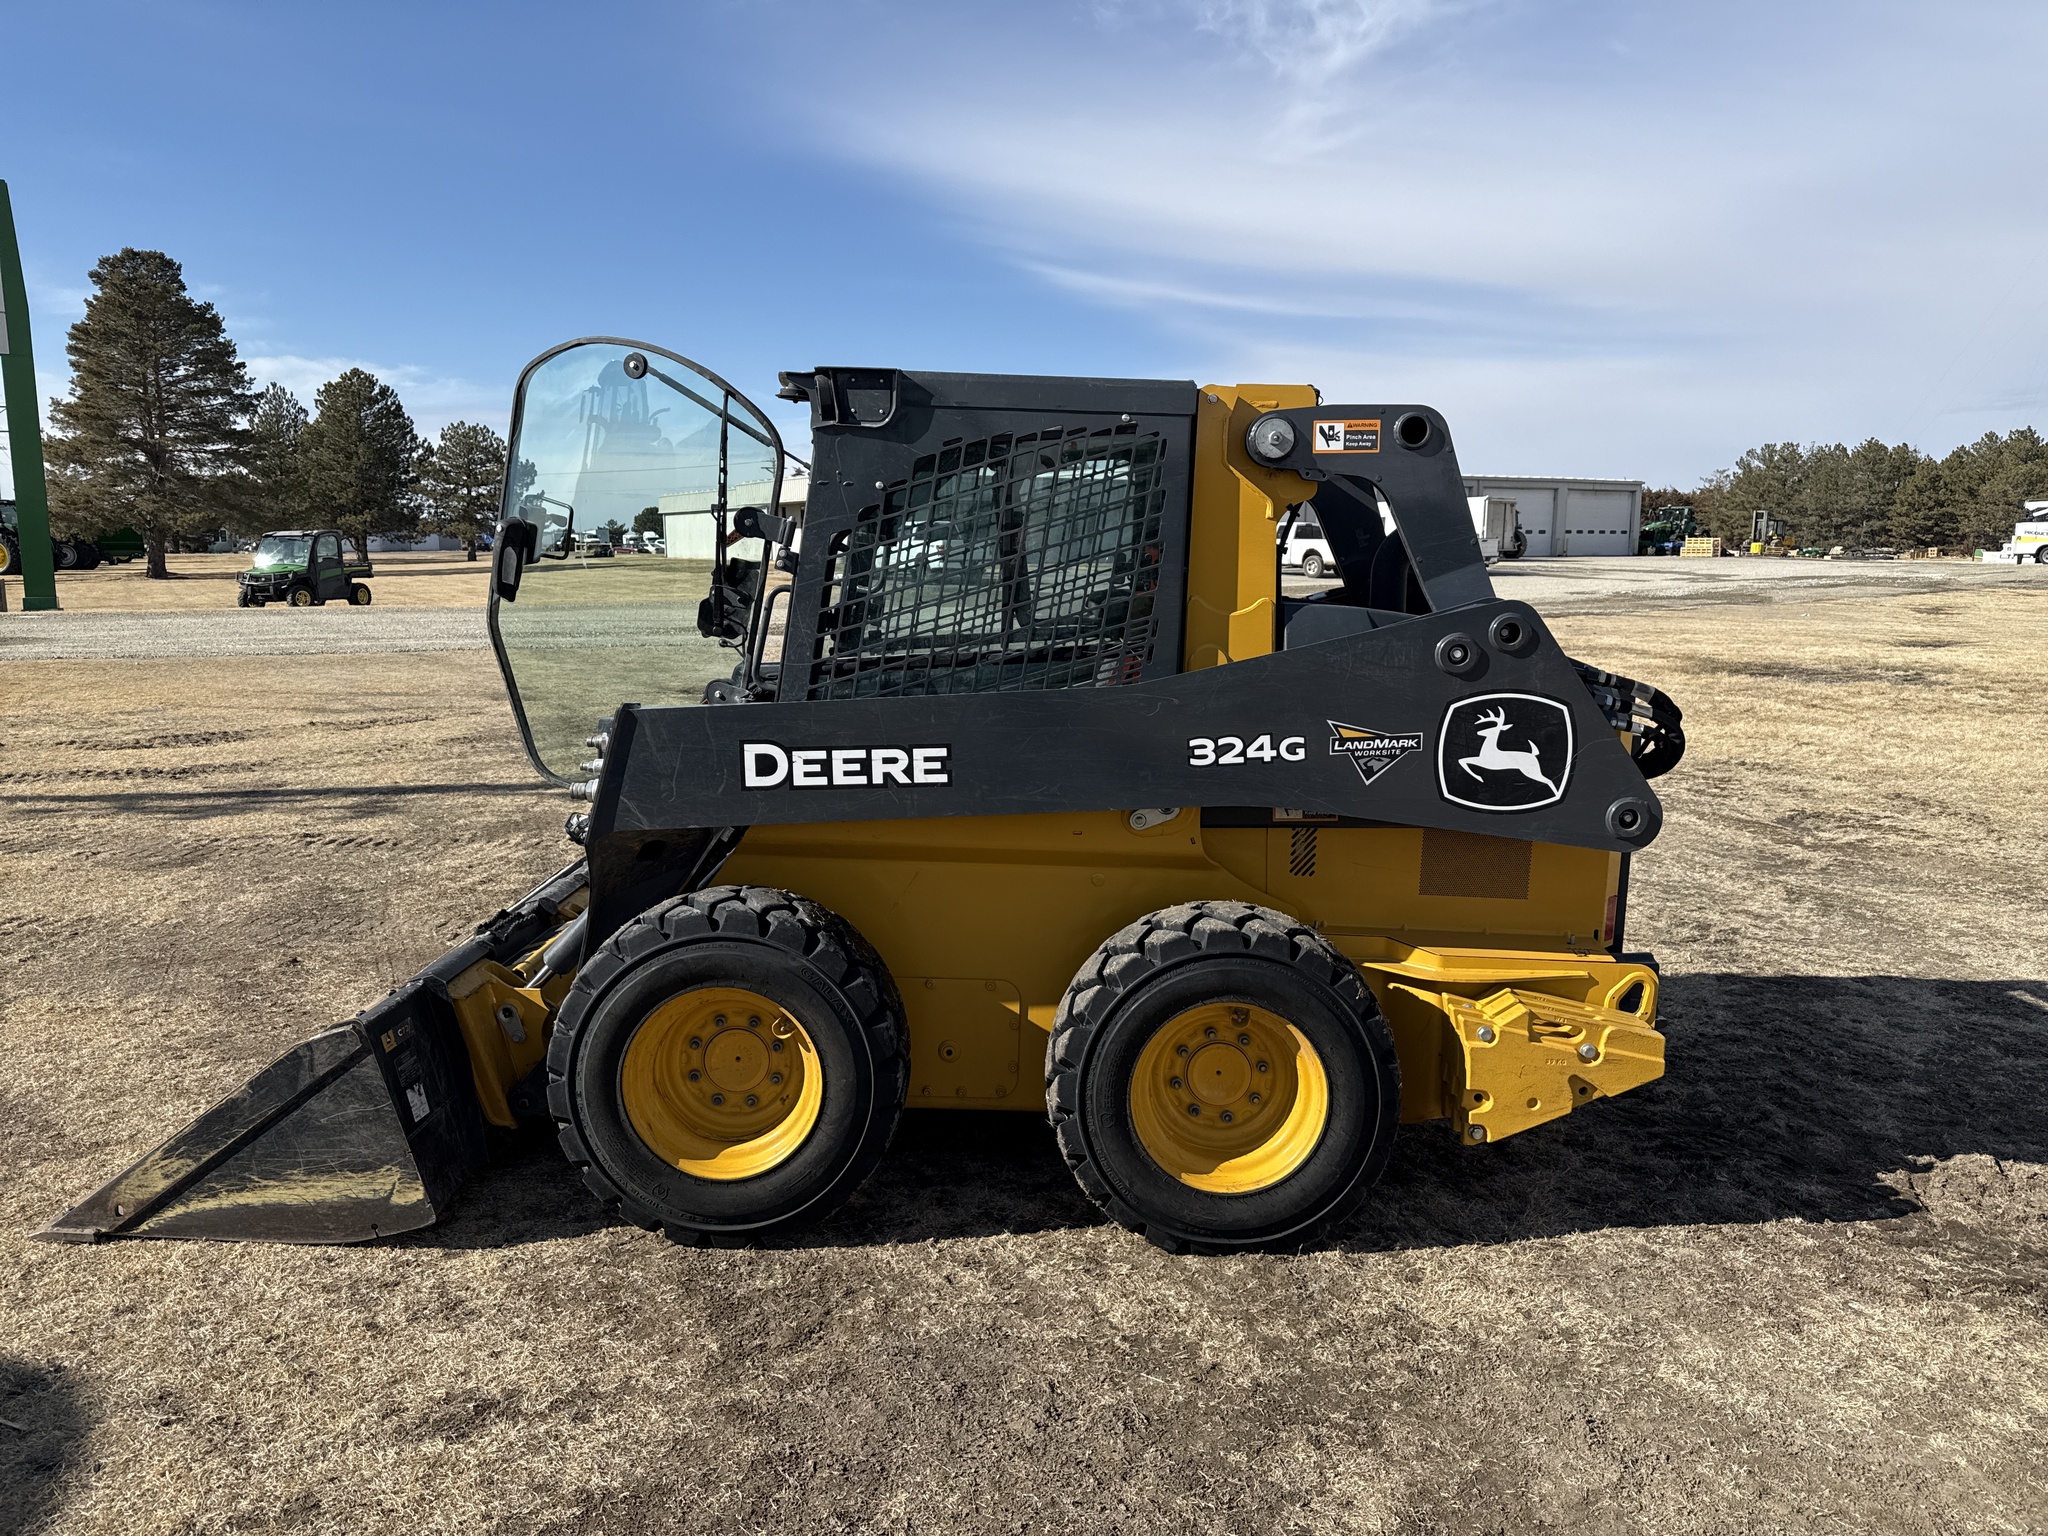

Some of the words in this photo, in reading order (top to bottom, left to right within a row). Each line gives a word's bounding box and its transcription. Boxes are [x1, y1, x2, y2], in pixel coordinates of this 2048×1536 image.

[743, 743, 949, 787] DEERE
[1189, 734, 1306, 766] 324G
[1354, 749, 1402, 757] WORKSITE
